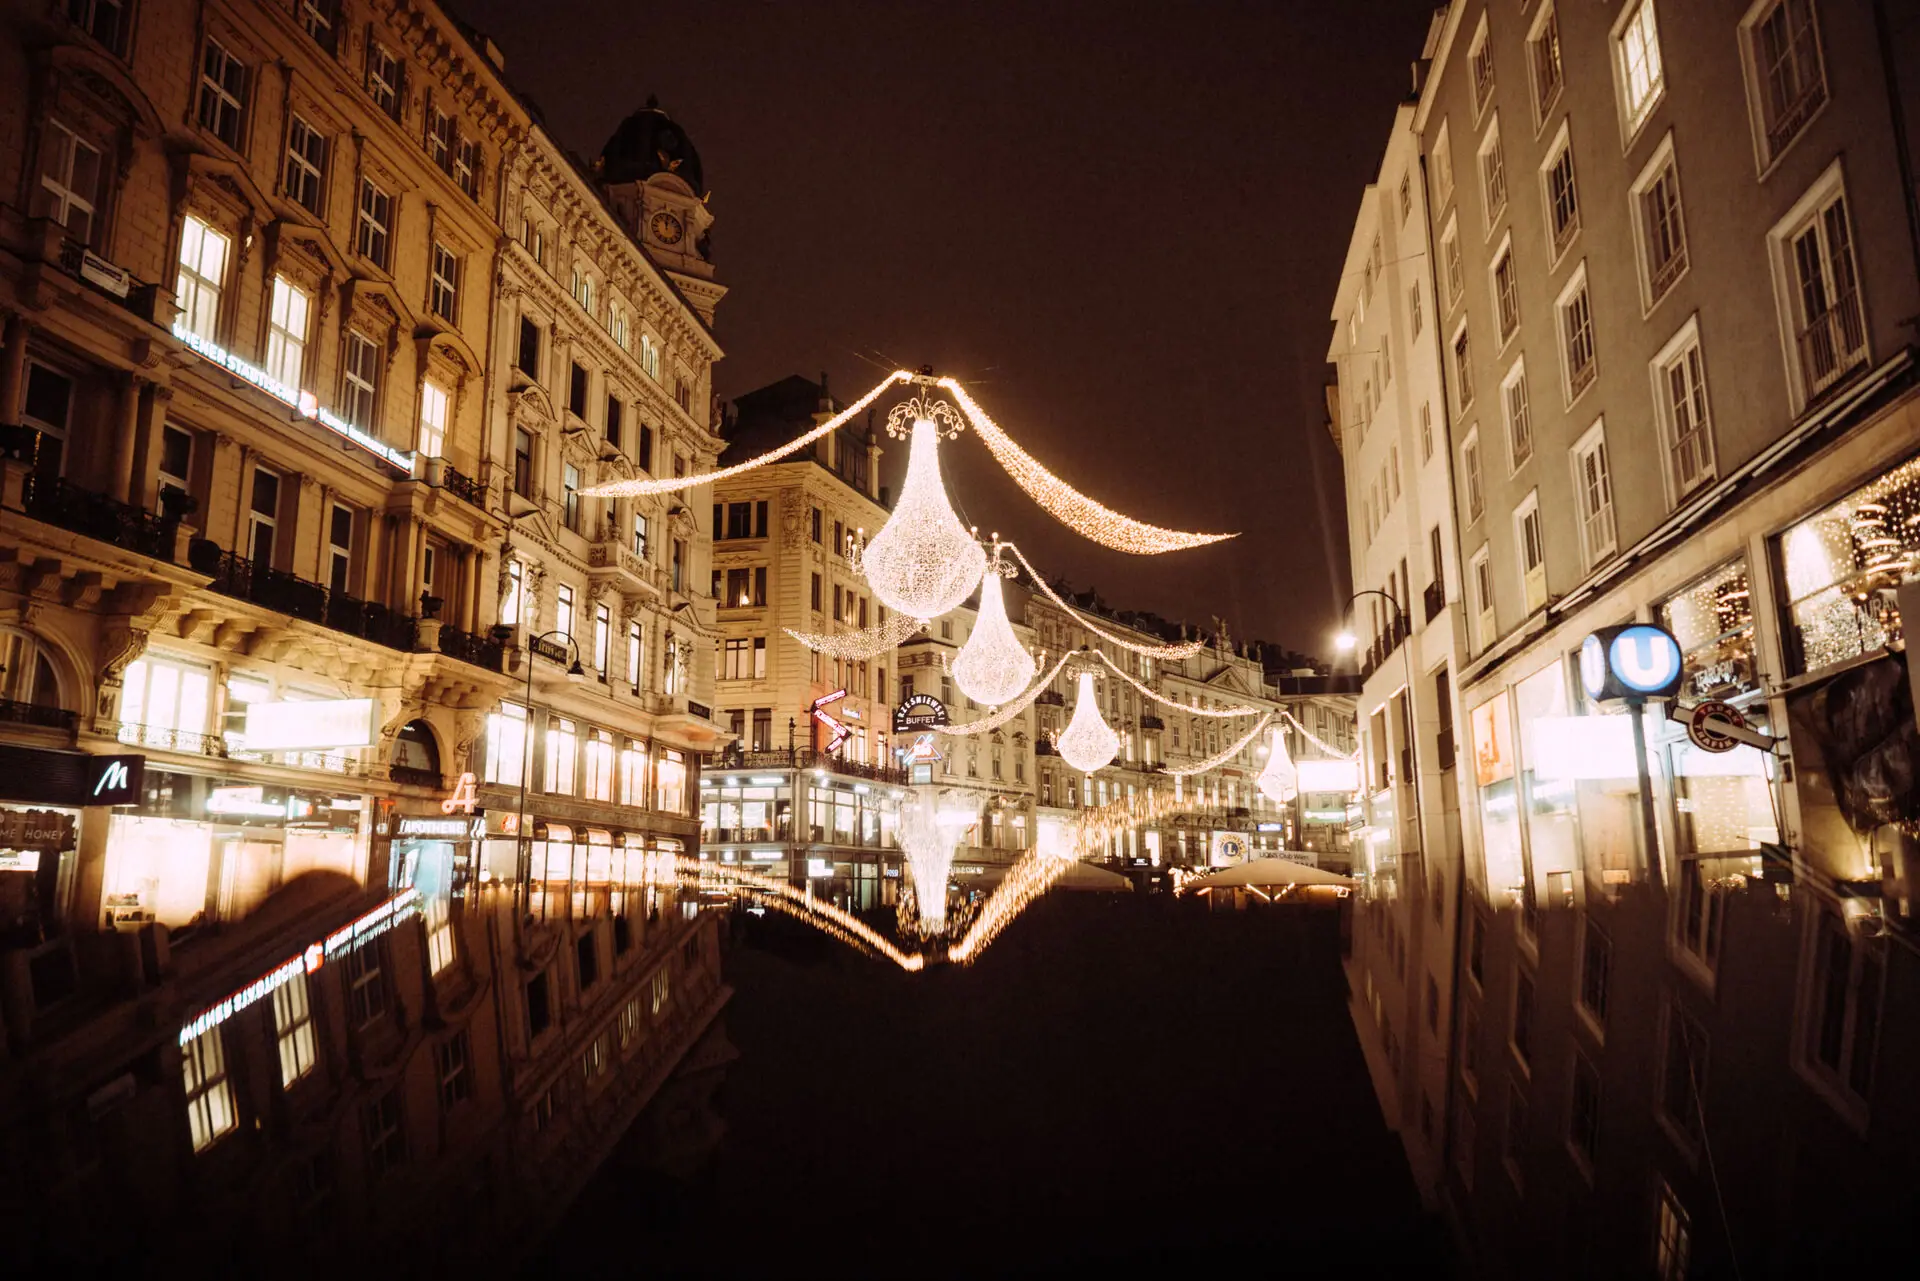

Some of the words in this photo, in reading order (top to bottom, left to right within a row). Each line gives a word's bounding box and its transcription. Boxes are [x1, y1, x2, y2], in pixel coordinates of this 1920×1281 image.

[172, 323, 227, 366] WIENER
[1618, 636, 1671, 686] U
[906, 716, 936, 724] BUFFET
[1694, 724, 1733, 748] TRAFIK
[93, 761, 128, 796] M
[24, 829, 66, 840] HONEY
